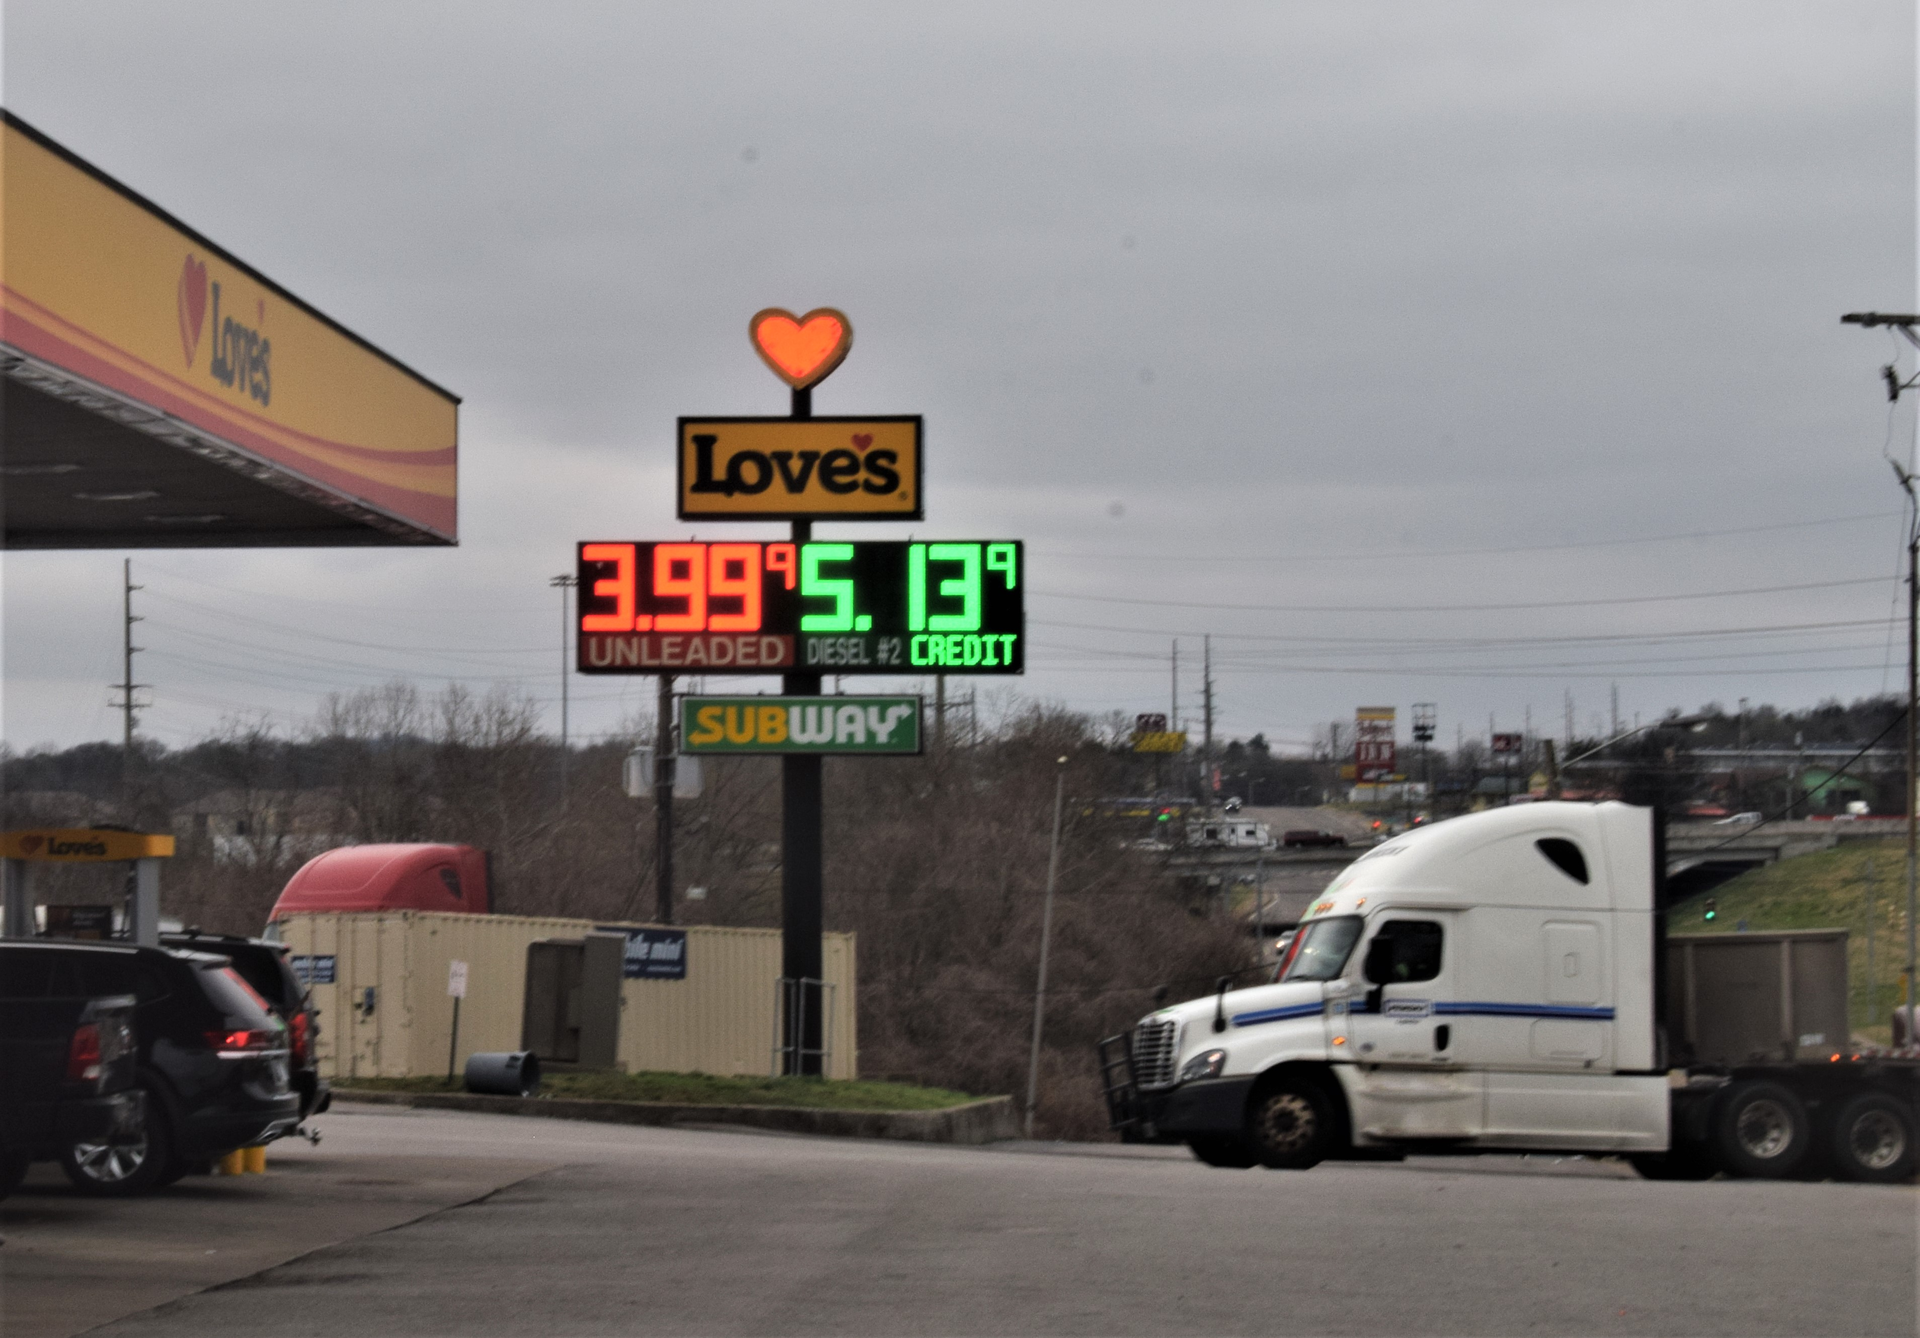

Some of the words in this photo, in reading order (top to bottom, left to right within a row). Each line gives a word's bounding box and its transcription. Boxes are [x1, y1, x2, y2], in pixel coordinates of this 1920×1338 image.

[589, 635, 786, 666] UNLEADED
[806, 636, 872, 666] DIESEL
[876, 636, 903, 666] #2
[911, 634, 1017, 666] CREDIT
[687, 703, 914, 746] SUBWAY
